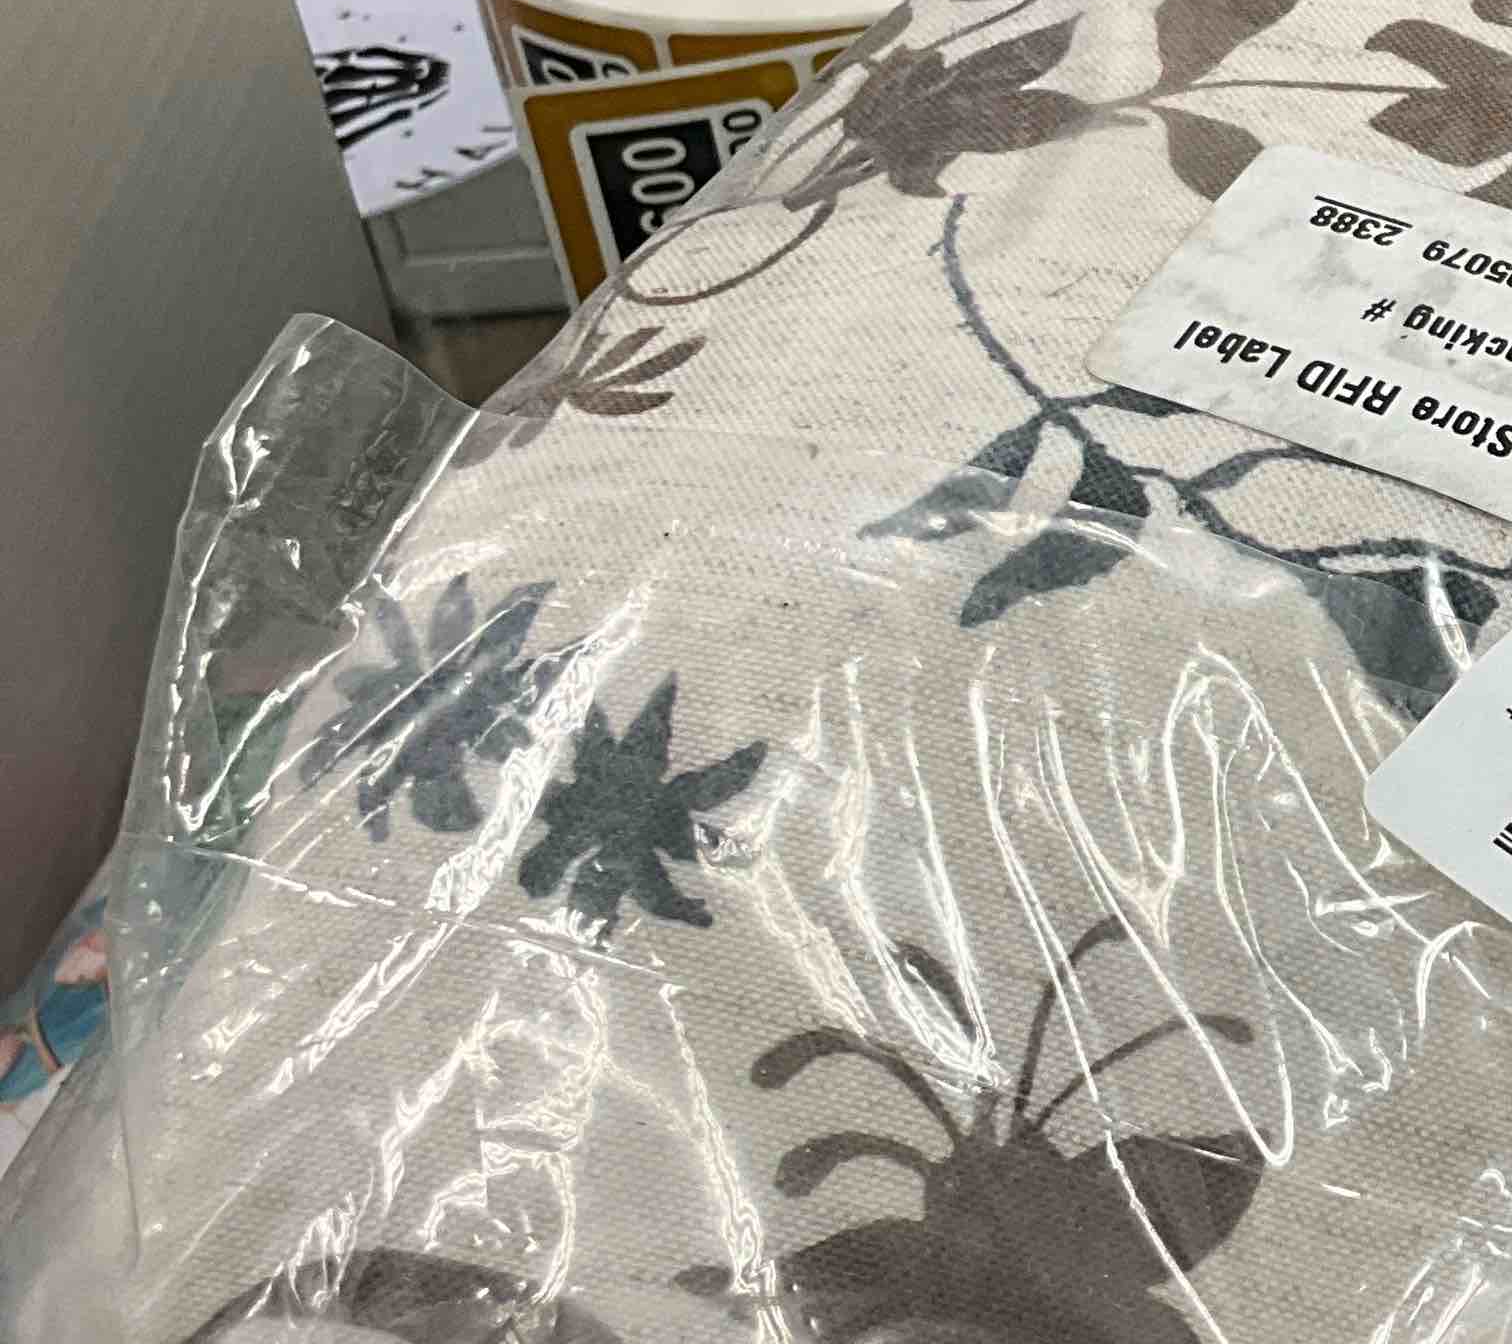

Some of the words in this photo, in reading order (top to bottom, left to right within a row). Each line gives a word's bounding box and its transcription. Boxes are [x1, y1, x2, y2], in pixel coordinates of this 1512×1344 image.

[1309, 202, 1404, 249] 2388
[1361, 298, 1399, 324] #
[1172, 319, 1290, 380] Label
[1295, 359, 1401, 418] RFID
